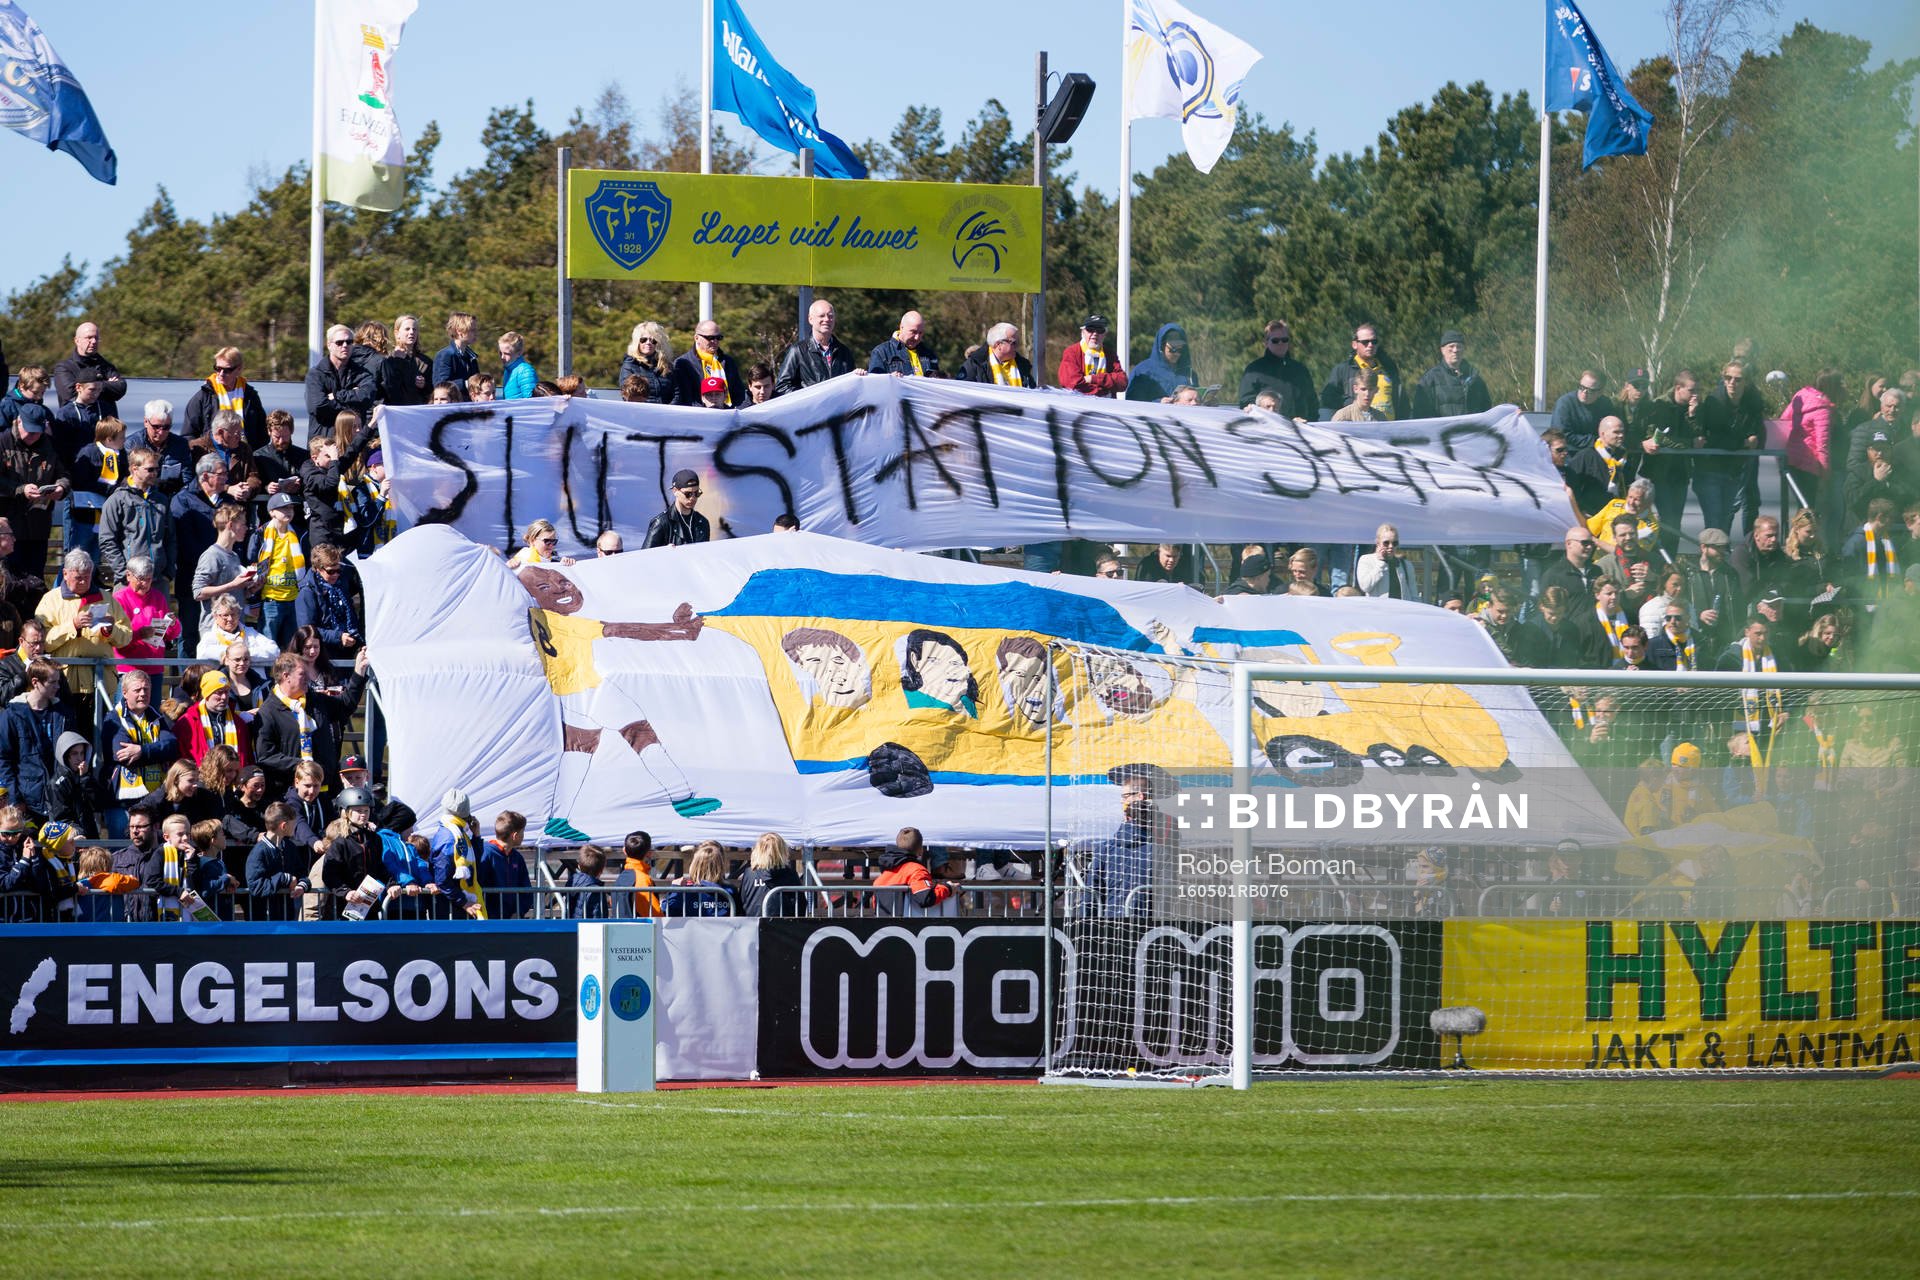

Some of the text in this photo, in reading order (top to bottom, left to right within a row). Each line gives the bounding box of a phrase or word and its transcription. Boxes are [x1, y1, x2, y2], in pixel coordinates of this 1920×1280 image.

[618, 244, 642, 253] 1928
[693, 210, 780, 258] Laget
[789, 214, 840, 248] vid
[841, 215, 919, 250] havet
[692, 901, 734, 909] SENSO
[67, 957, 560, 1026] ENGELSONS
[1585, 1032, 1920, 1070] JAKT & LANTMA
